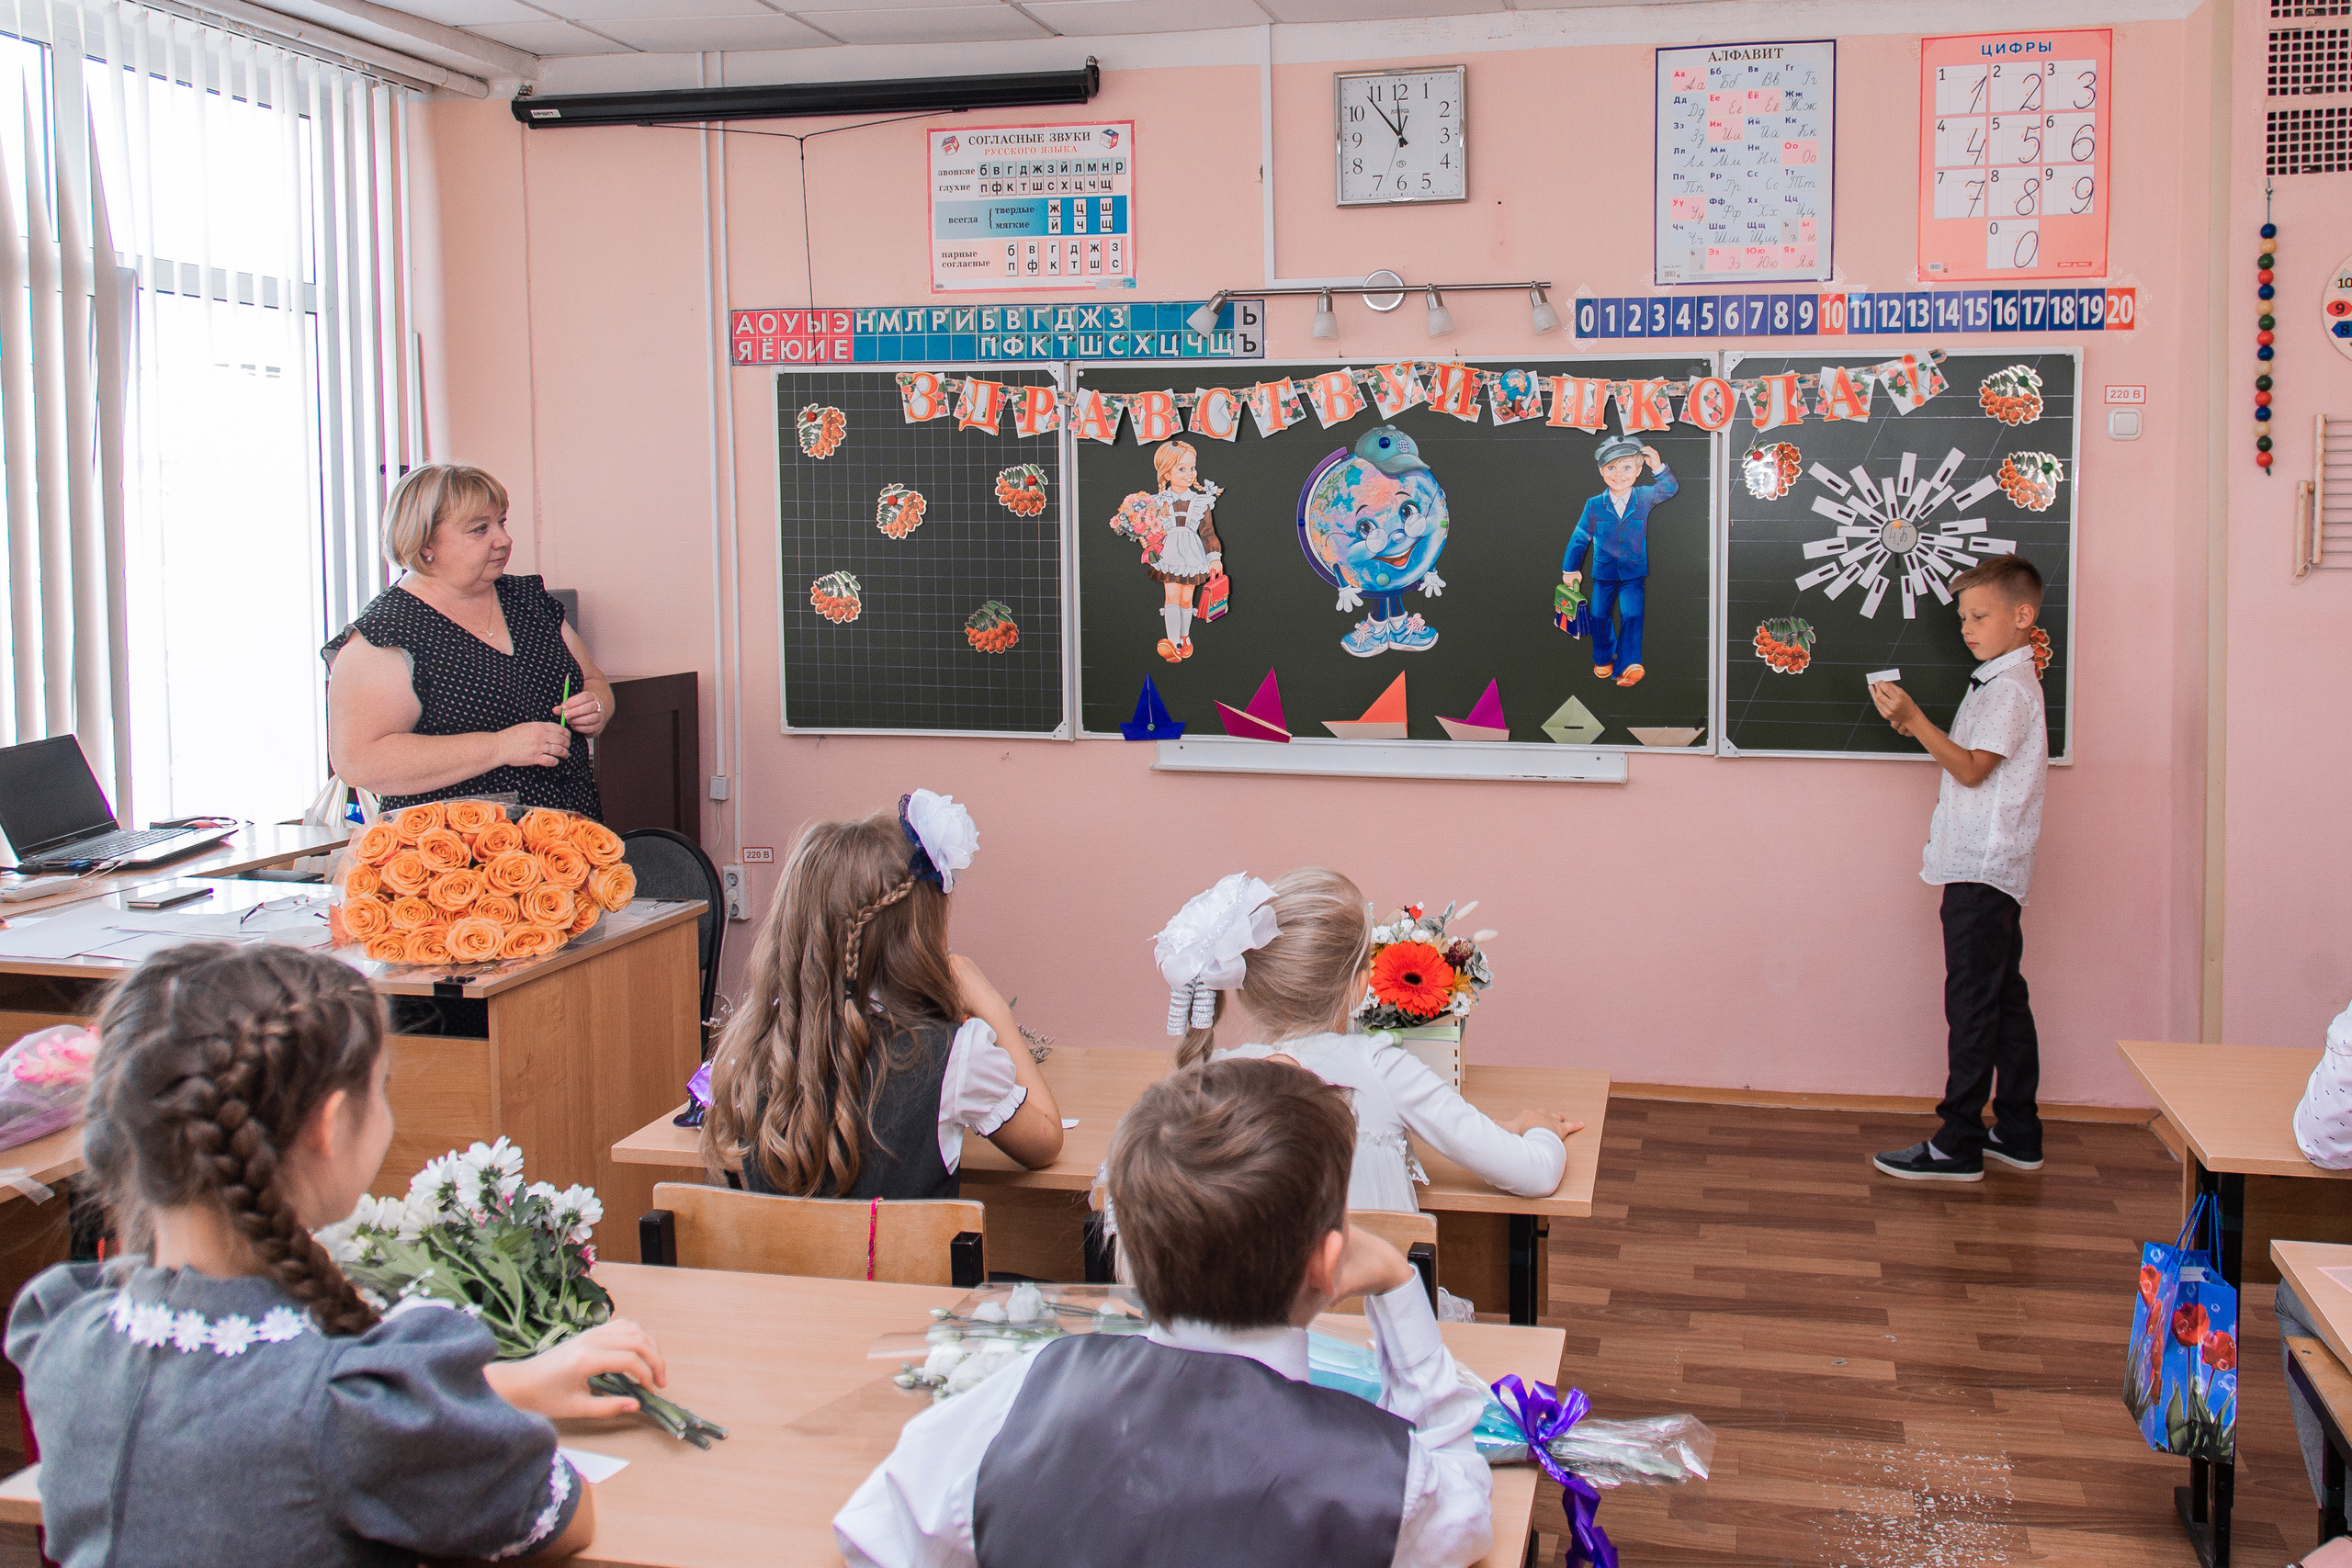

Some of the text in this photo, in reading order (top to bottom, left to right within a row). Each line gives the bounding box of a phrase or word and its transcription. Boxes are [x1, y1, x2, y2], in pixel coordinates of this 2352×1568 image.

[1707, 48, 1784, 62] АЛФАВИТ
[1981, 41, 2052, 57] ЦИФРЫ
[1369, 85, 1382, 102] 11
[1392, 84, 1408, 101] 12
[1423, 82, 1429, 99] 1
[1939, 63, 2097, 114] 1 1 2 2 3 3
[1349, 105, 1365, 122] 10
[1439, 101, 1450, 118] 2
[968, 131, 1091, 146] СОГЛАСНЫЕ ЗВУКИ
[1351, 132, 1363, 149] 9
[1440, 127, 1450, 143] 3
[1937, 115, 2095, 165] 4 4 5 5 6 6
[984, 145, 1078, 156] РУССКОГО ЯЗЫКА
[1352, 158, 1363, 175] 8
[1440, 152, 1451, 169] 4
[937, 162, 1123, 176] звонкие б в г д ж з й л м н р
[938, 179, 1112, 195] глухие п ф к т ш с х ц ч щ
[1372, 175, 1384, 191] 7
[1396, 174, 1408, 191] 6
[1421, 173, 1431, 189] 5
[1937, 168, 2094, 218] 7 7 8 8 9 9
[994, 203, 1112, 214] твердые ж ц ш
[948, 216, 978, 224] всегда
[995, 219, 1112, 231] мягкие й ч щ
[1008, 244, 1015, 256] б
[1051, 245, 1057, 254] г
[1070, 245, 1079, 255] д
[1090, 243, 1100, 253] ж
[1112, 243, 1118, 252] з
[1990, 222, 2039, 268] 0 0
[942, 250, 978, 259] парные
[942, 260, 990, 268] согласные
[1008, 259, 1119, 273] п ф к т ш с
[2337, 277, 2352, 288] 10
[1580, 295, 2133, 333] 0 1 2 3 4 5 6 7 8 9 10 11 12 13 14 15 16 17 18 19 20
[2335, 302, 2346, 314] 9
[2340, 323, 2350, 335] 8
[906, 354, 1927, 441] ЗДРАВСТВУЙ ШКОЛА!
[2110, 389, 2141, 398] 220 В
[746, 851, 761, 859] 220
